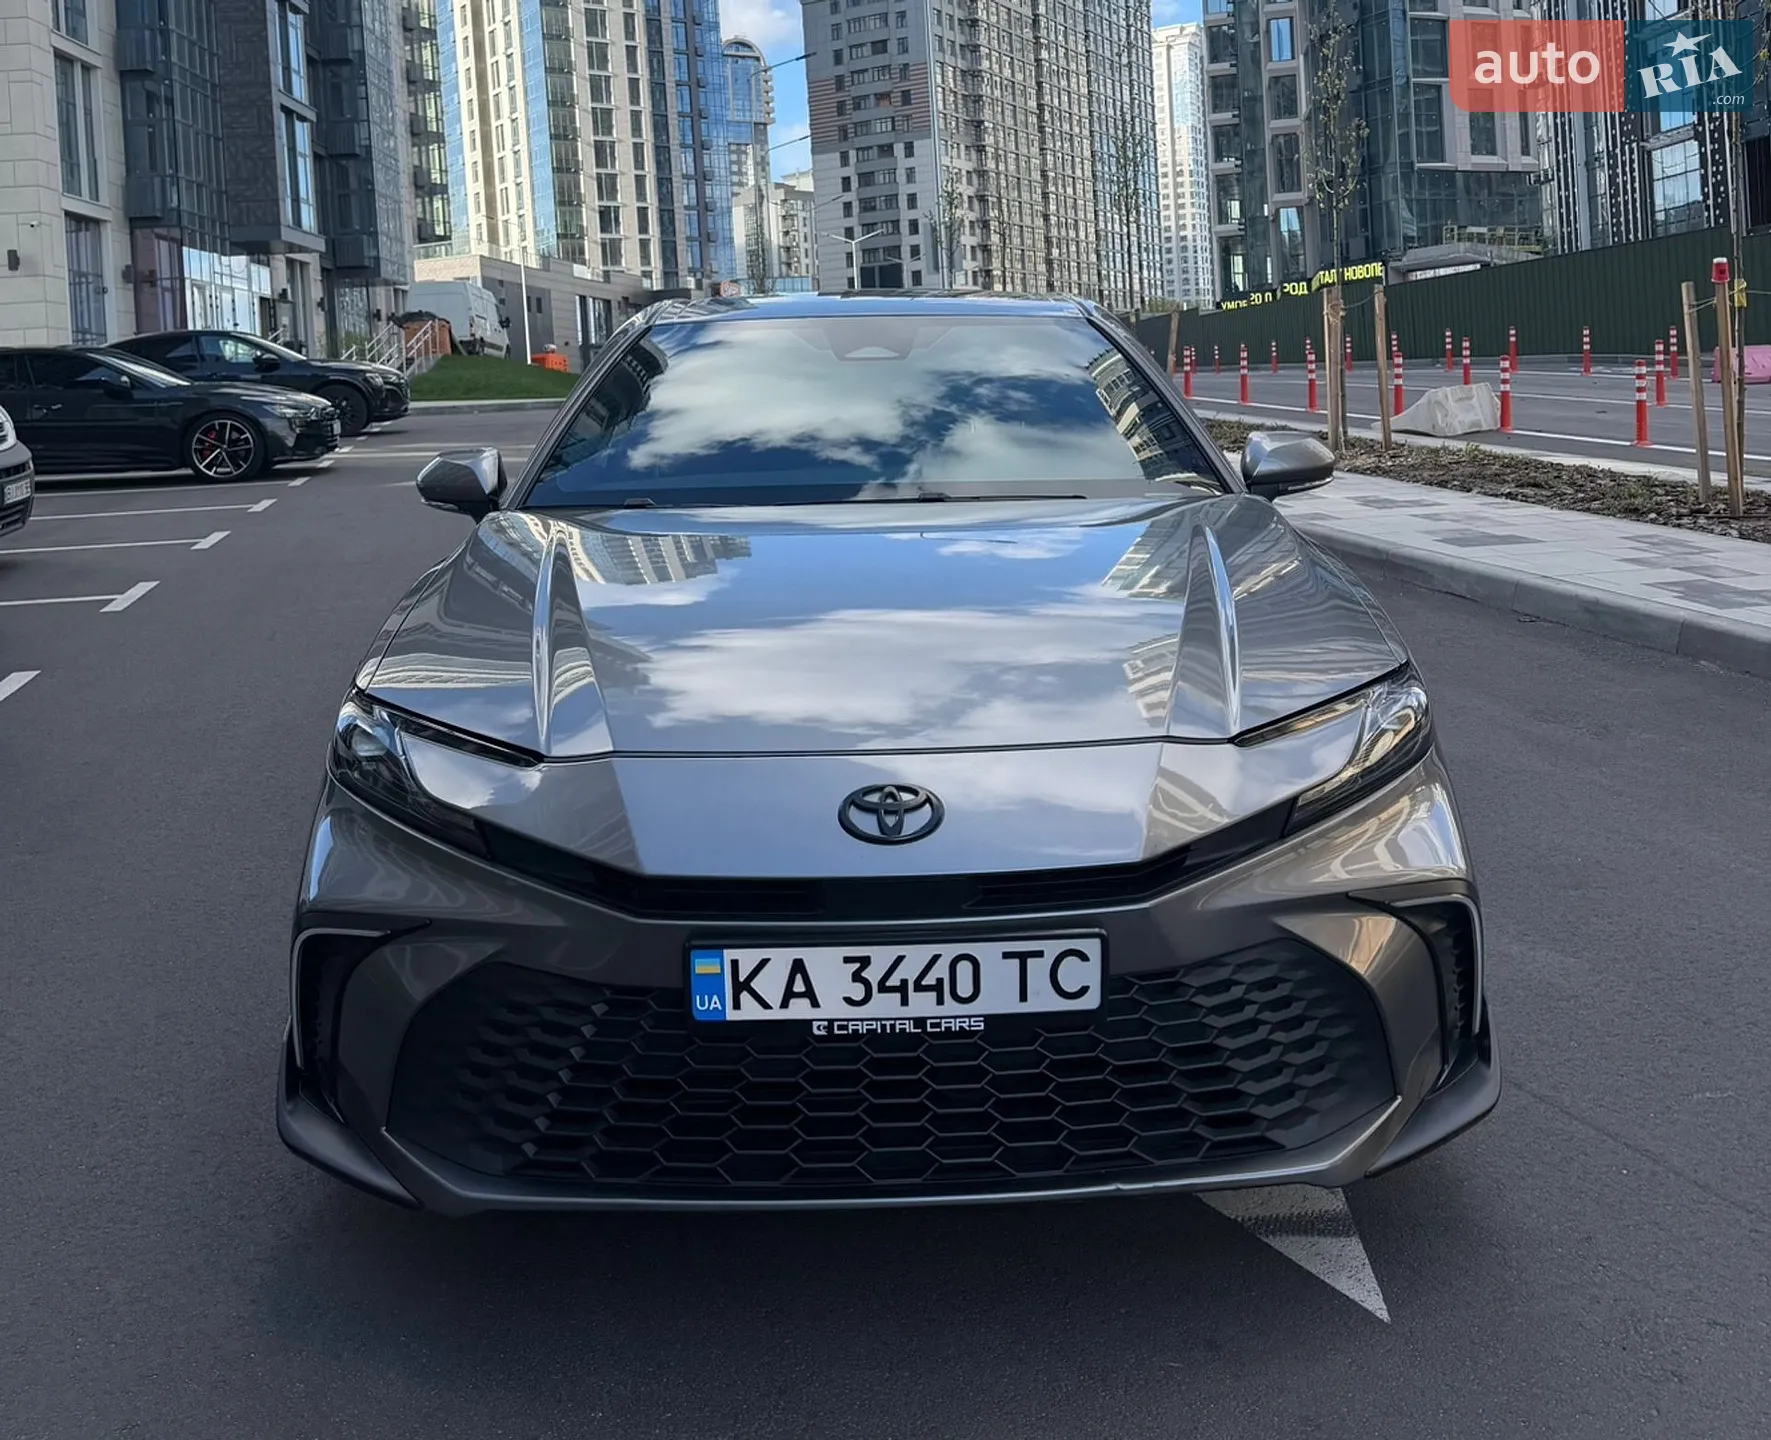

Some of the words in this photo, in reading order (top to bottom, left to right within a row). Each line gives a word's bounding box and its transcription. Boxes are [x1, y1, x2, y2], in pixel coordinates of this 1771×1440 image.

[730, 957, 821, 1011] KA
[841, 953, 982, 1007] 3440
[1001, 948, 1091, 1003] TC
[696, 994, 723, 1011] UA
[833, 1020, 922, 1035] CAPITAL
[926, 1017, 985, 1033] CARS
